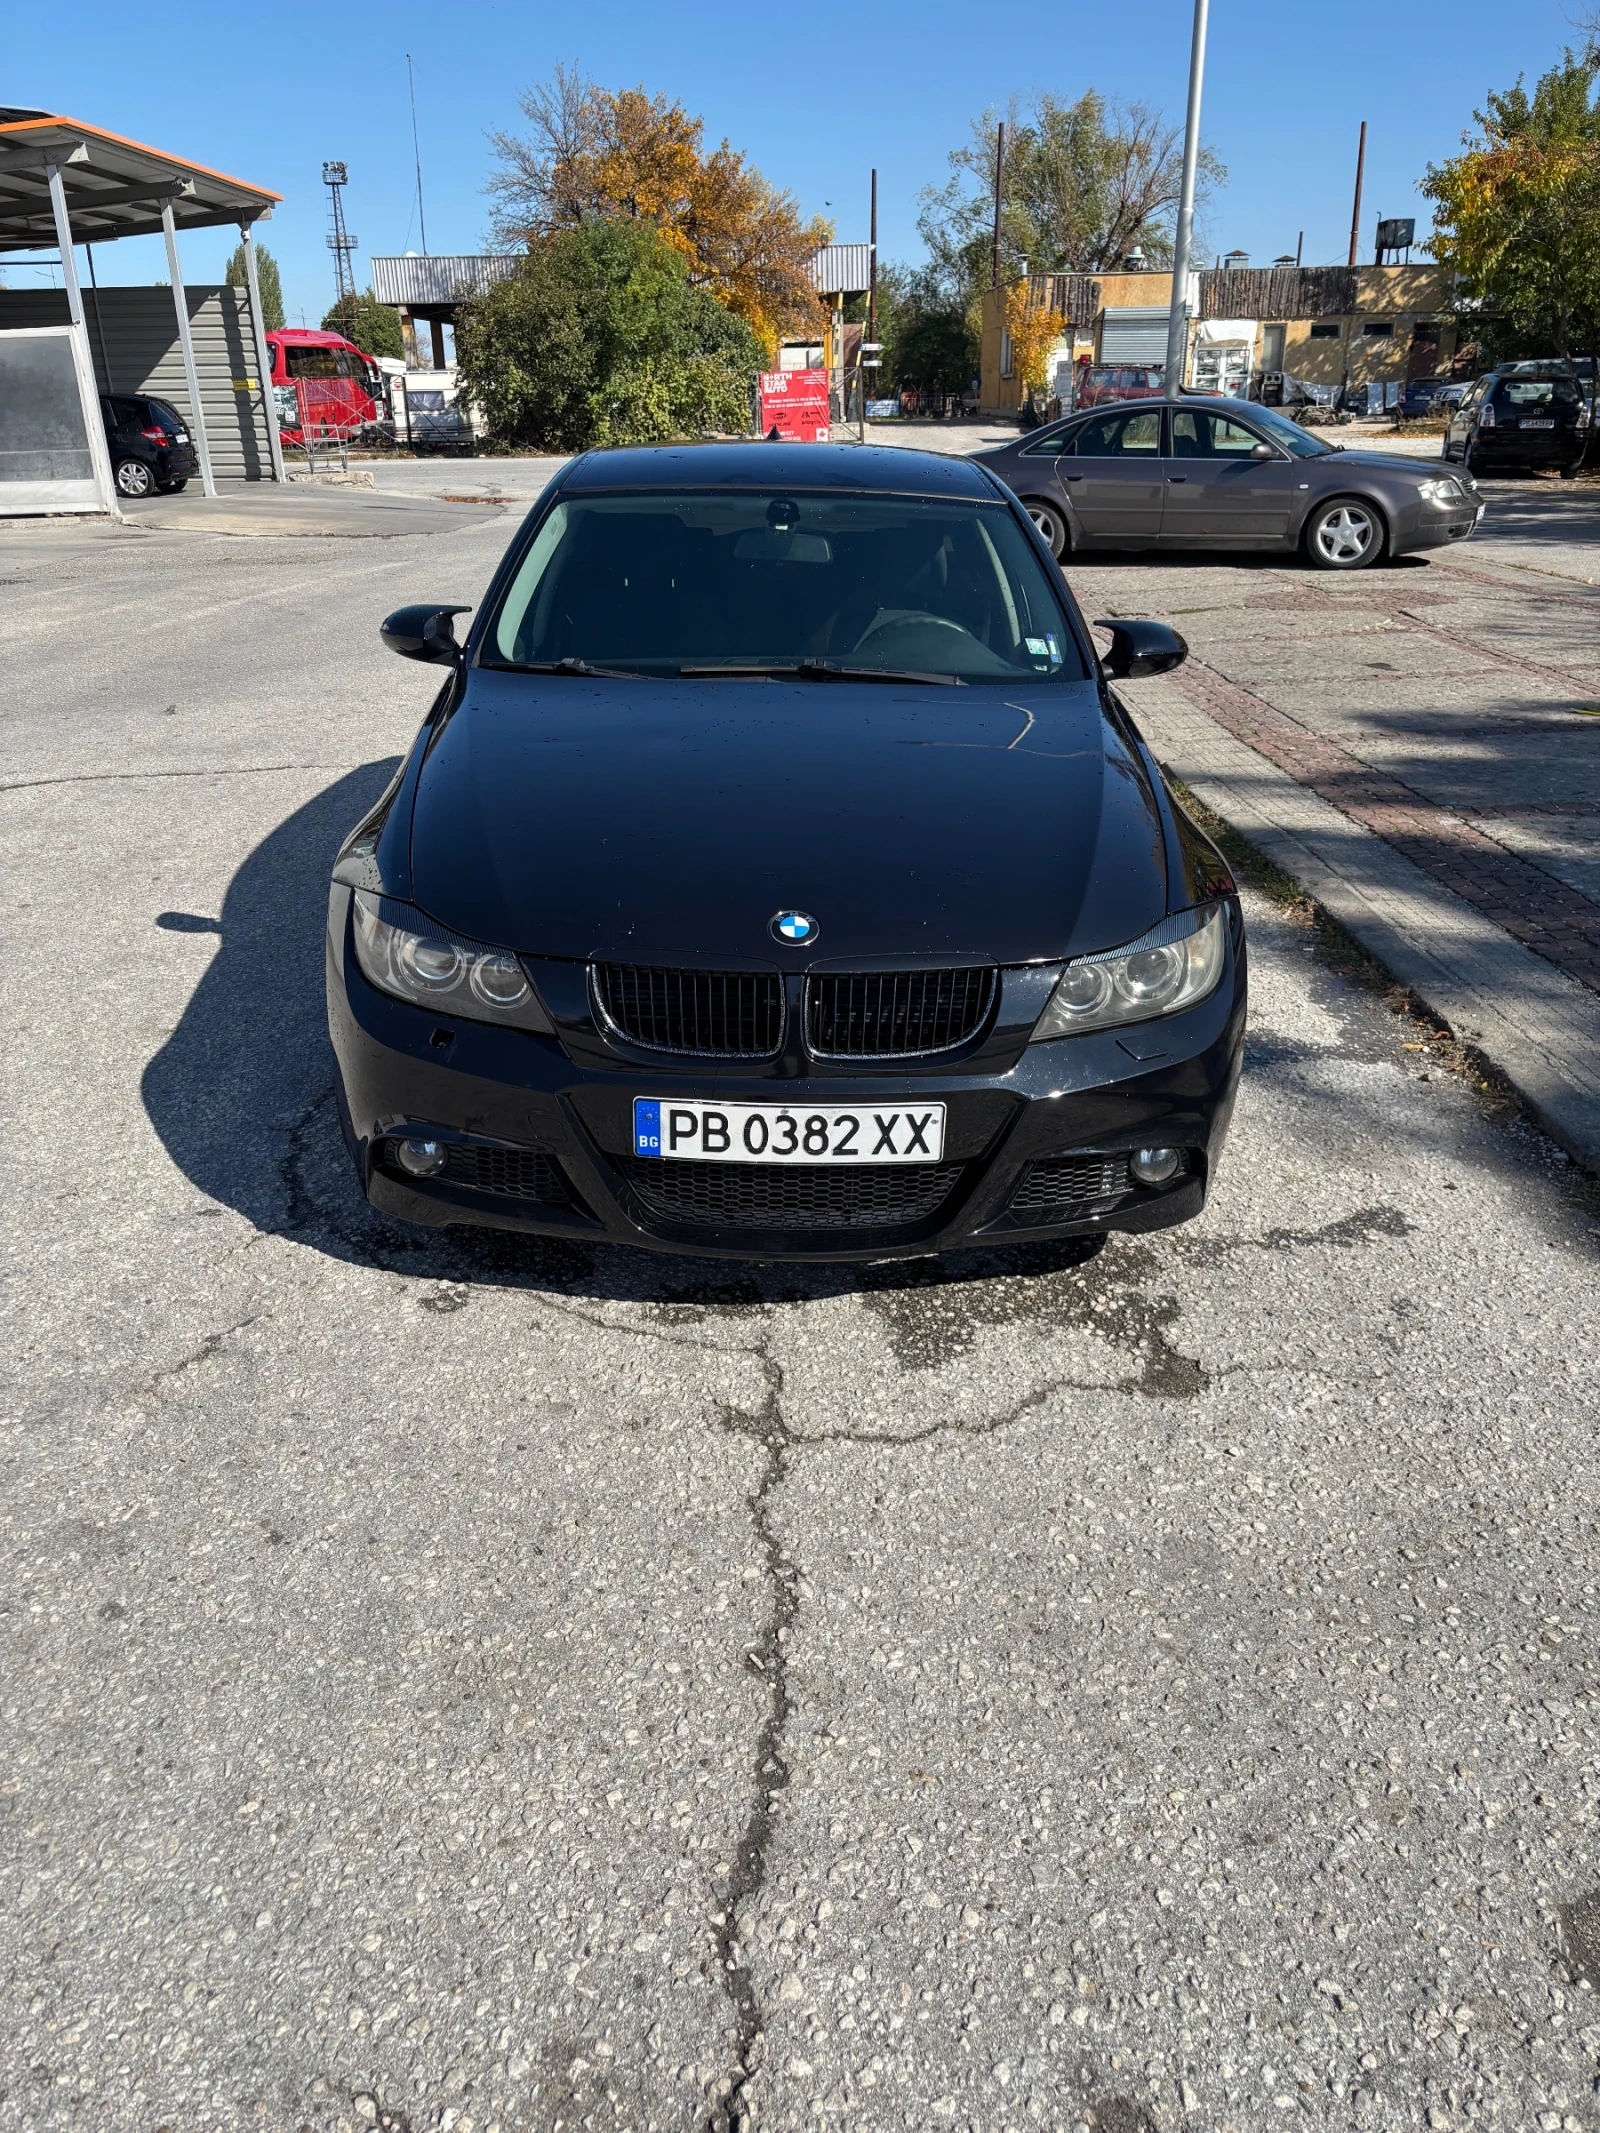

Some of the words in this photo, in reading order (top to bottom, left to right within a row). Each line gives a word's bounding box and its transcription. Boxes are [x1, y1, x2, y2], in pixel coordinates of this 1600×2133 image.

[764, 386, 788, 394] AUTO
[775, 912, 814, 922] BMW
[669, 1109, 731, 1153] PB
[743, 1113, 860, 1156] 0382
[872, 1112, 933, 1155] XX
[639, 1135, 659, 1149] BG
